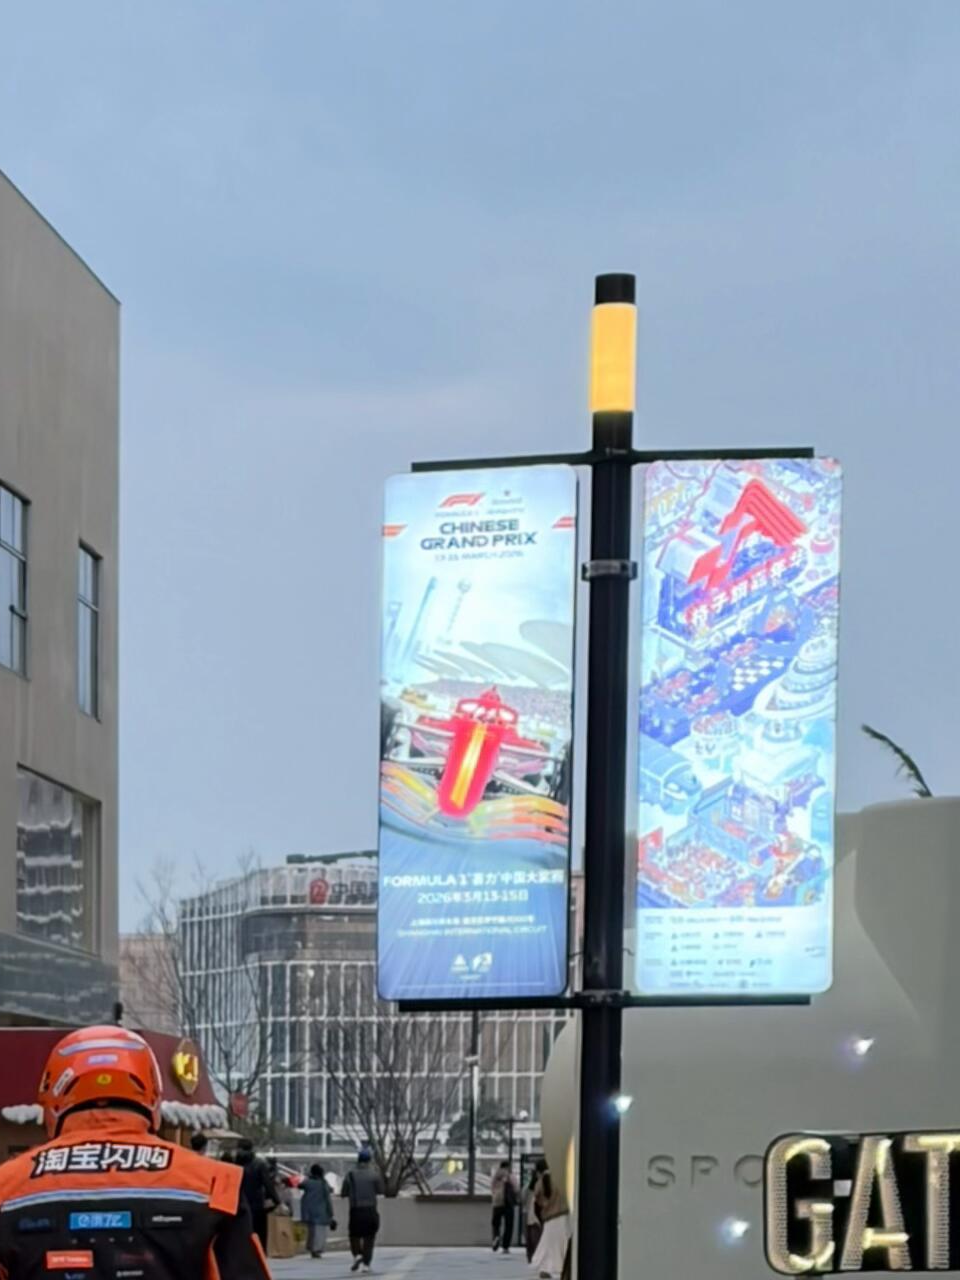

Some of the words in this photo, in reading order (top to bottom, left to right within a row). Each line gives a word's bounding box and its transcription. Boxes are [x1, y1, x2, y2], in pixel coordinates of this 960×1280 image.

[439, 519, 519, 535] CHINESE
[420, 536, 489, 550] GRAND
[492, 531, 538, 547] PRIX
[383, 873, 456, 887] FORMULA
[35, 1143, 171, 1175] 淘宝闪购
